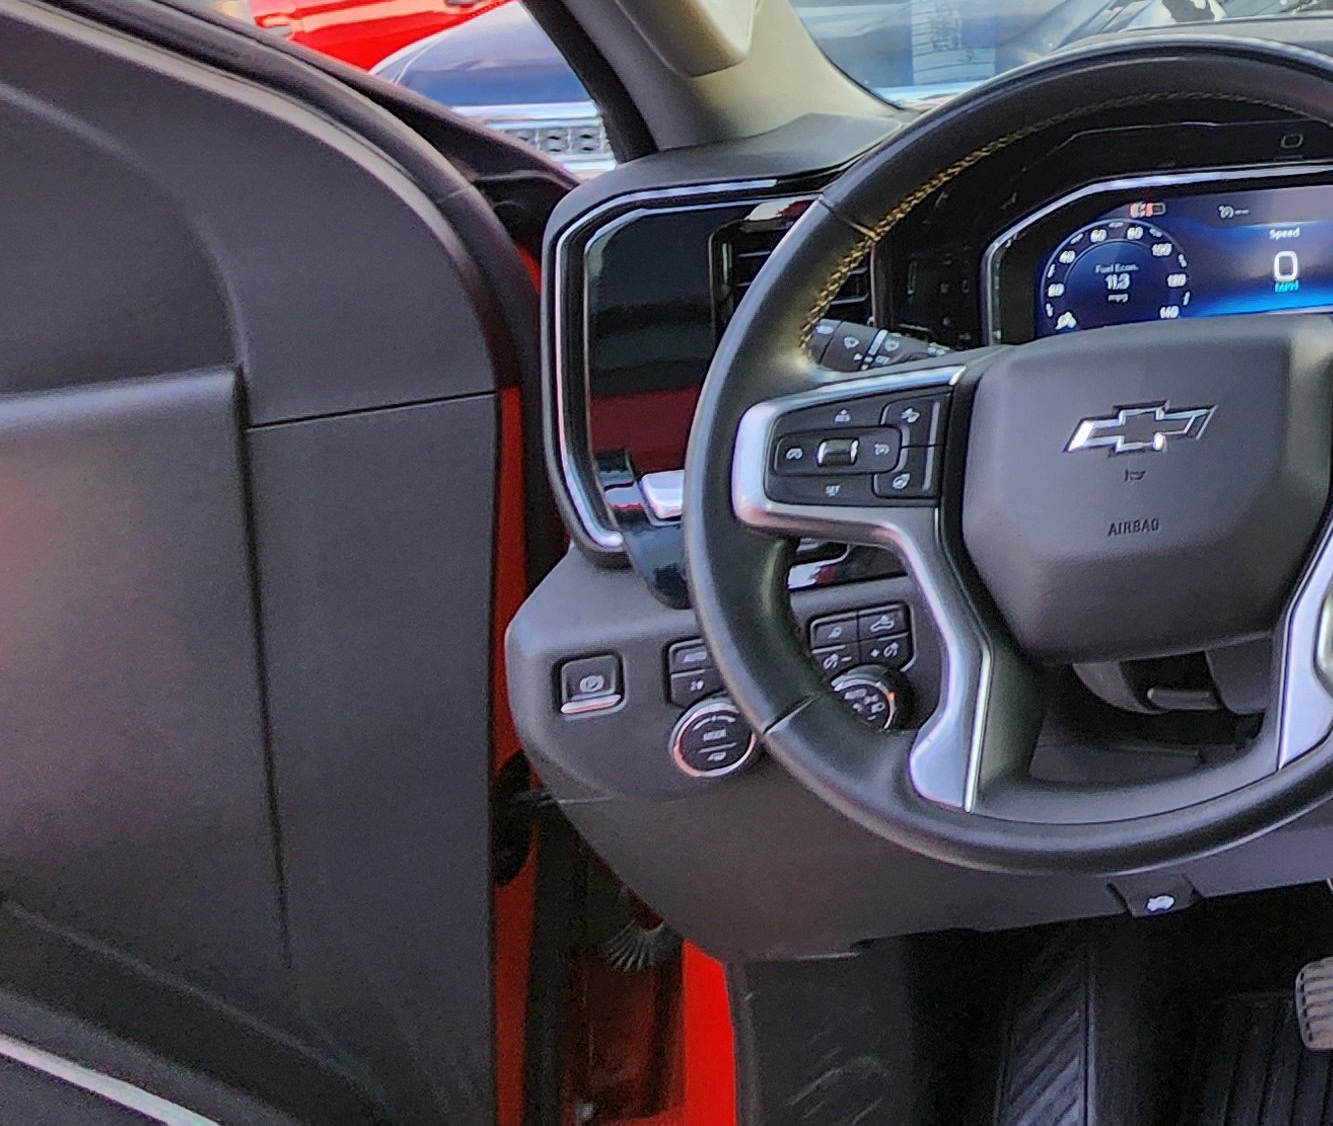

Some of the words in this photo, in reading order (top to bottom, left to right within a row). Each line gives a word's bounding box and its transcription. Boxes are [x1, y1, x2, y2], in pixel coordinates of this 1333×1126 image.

[1269, 227, 1300, 240] Speed
[1095, 265, 1114, 274] Fuel
[1115, 263, 1139, 273] Econ.
[1274, 250, 1298, 281] 0
[1107, 294, 1129, 303] mpg
[1108, 517, 1160, 537] AIRBAG
